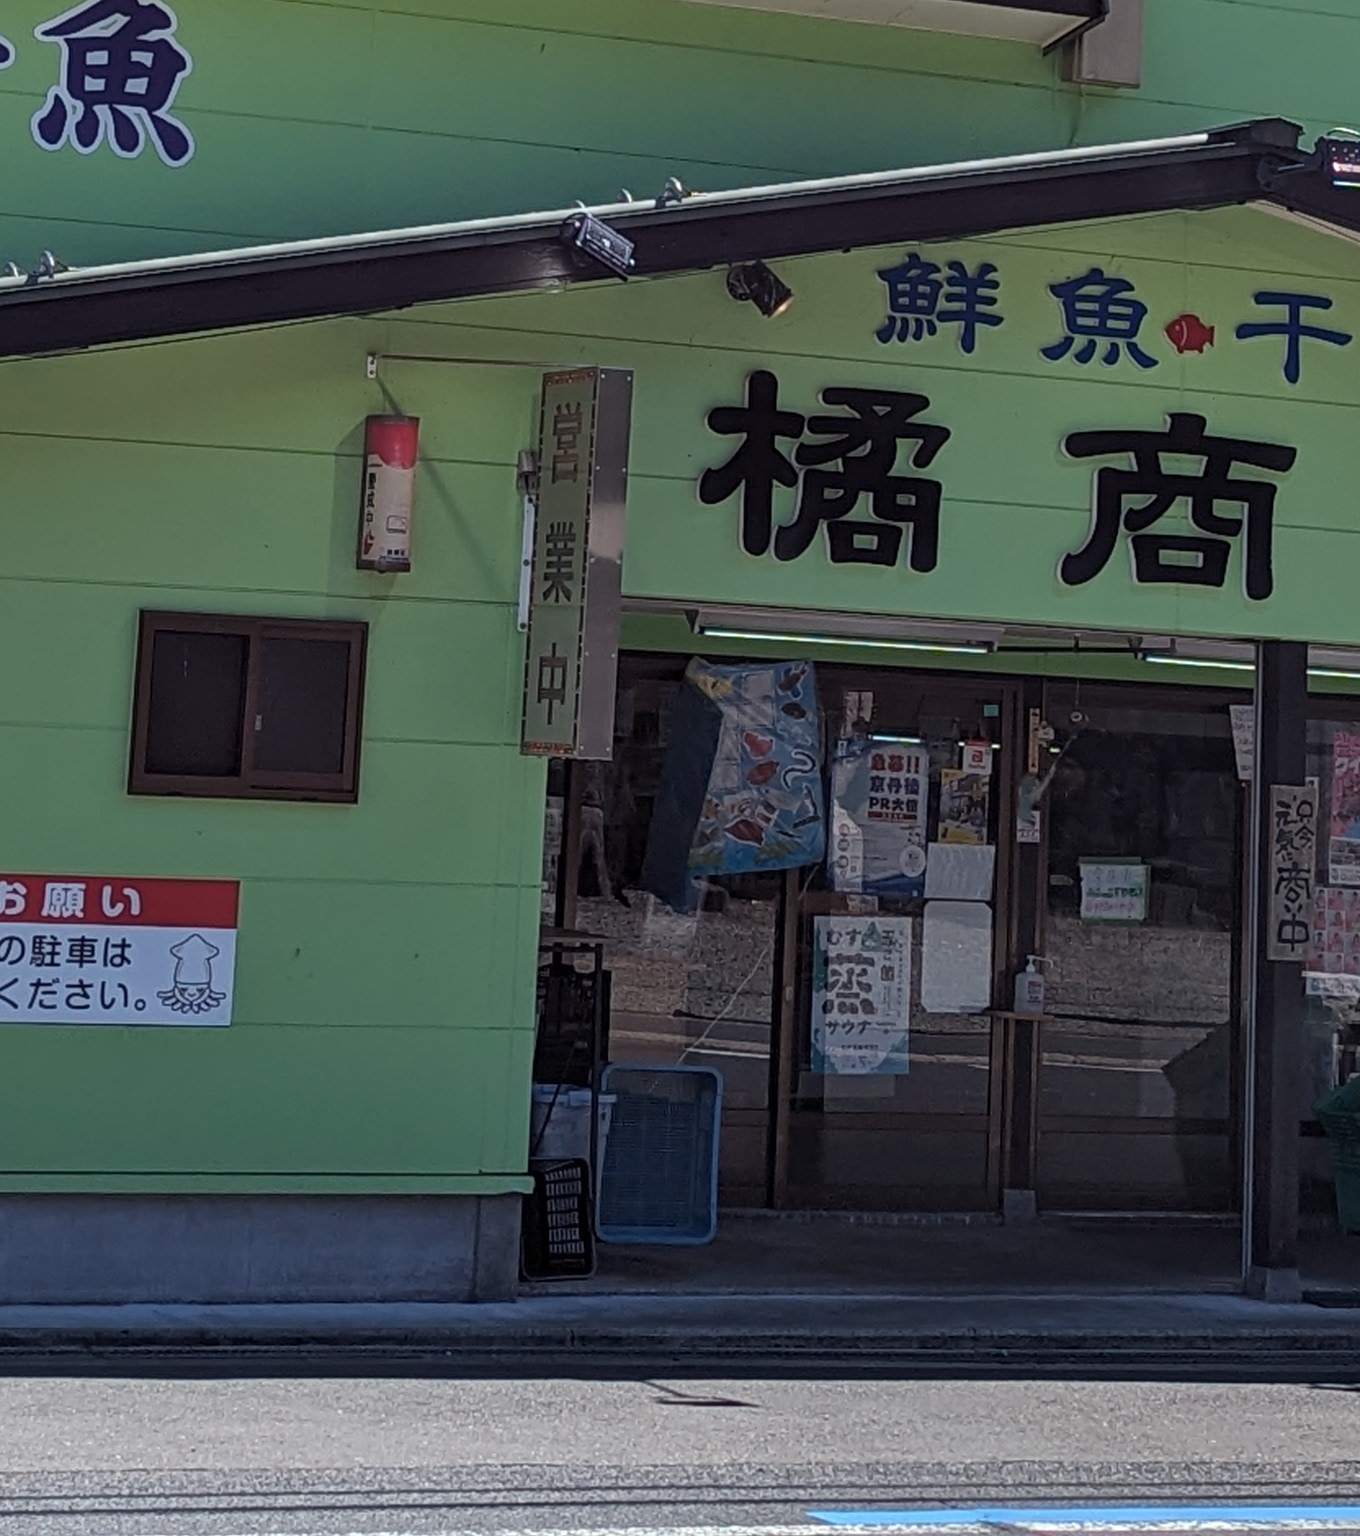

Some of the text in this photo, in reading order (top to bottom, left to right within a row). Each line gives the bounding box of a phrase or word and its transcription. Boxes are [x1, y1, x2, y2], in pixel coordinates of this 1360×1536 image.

[873, 252, 1160, 370] 鮮魚
[536, 401, 583, 726] 営業中
